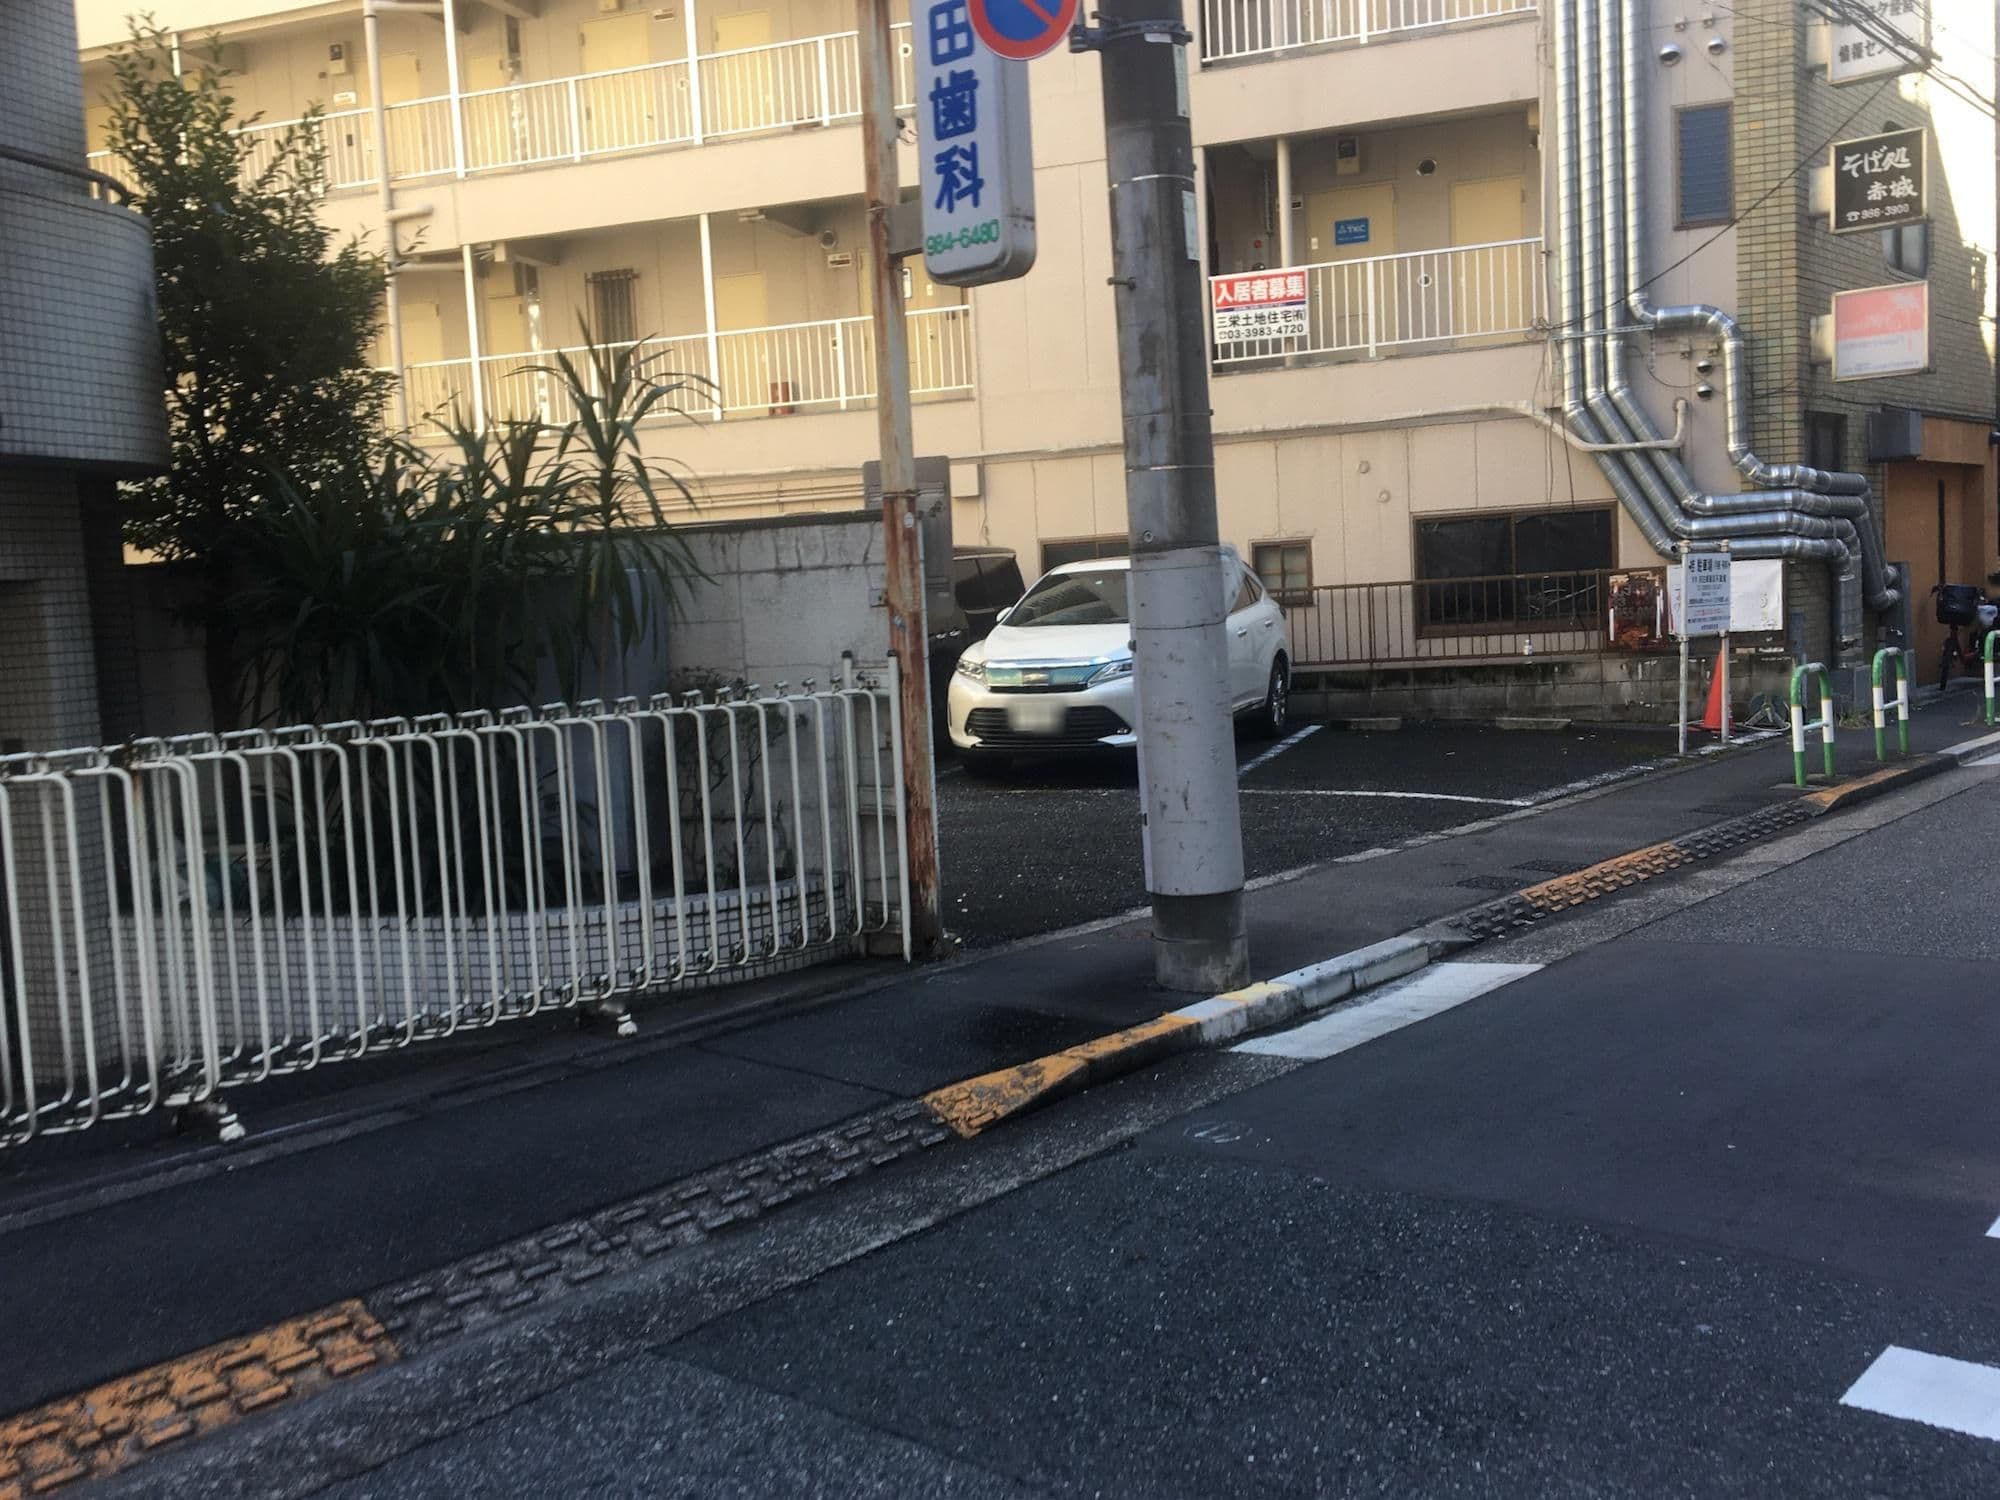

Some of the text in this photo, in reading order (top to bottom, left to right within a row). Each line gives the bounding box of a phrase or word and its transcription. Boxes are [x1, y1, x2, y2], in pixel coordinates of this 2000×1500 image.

[1841, 145, 1912, 177] そば処
[927, 219, 1000, 256] 984-6480
[1217, 274, 1305, 305] 入居者募集
[1227, 323, 1304, 340] 03-3983-4720
